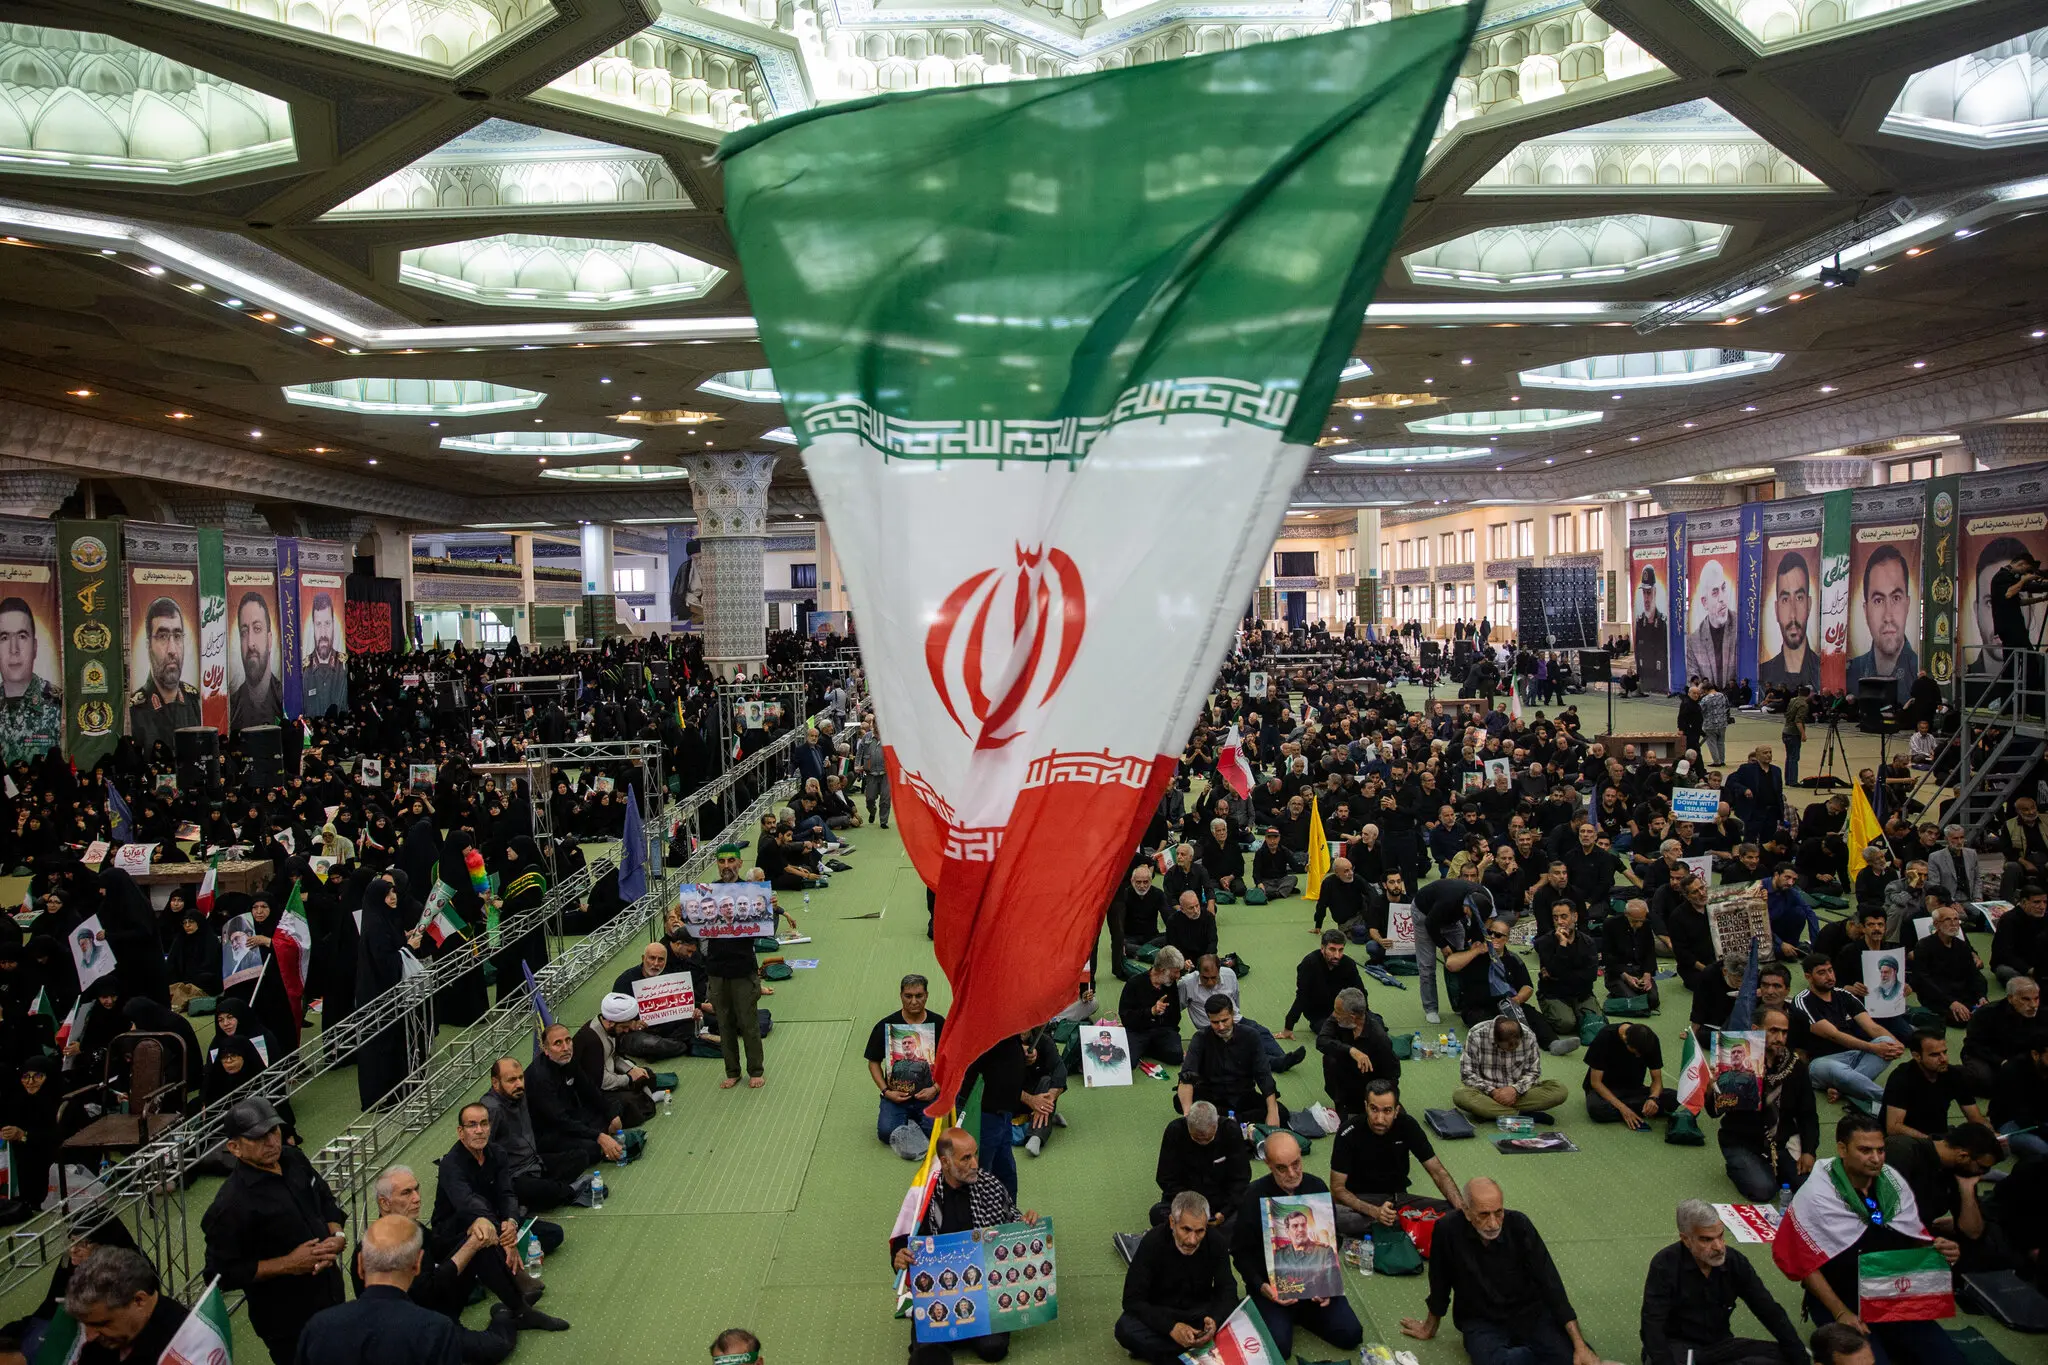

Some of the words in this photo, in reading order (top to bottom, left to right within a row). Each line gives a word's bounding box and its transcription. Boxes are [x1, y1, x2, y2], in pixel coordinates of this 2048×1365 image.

[2010, 519, 2024, 528] شهید
[2024, 517, 2043, 528] پاسدار
[1892, 529, 1901, 537] شهید
[1902, 527, 1916, 538] پاسدار
[19, 569, 32, 579] شهید
[203, 664, 224, 696] ایران
[668, 997, 679, 1008] بر
[679, 994, 693, 1004] مرگ
[641, 1012, 660, 1021] DOWN
[661, 1009, 677, 1018] WITH
